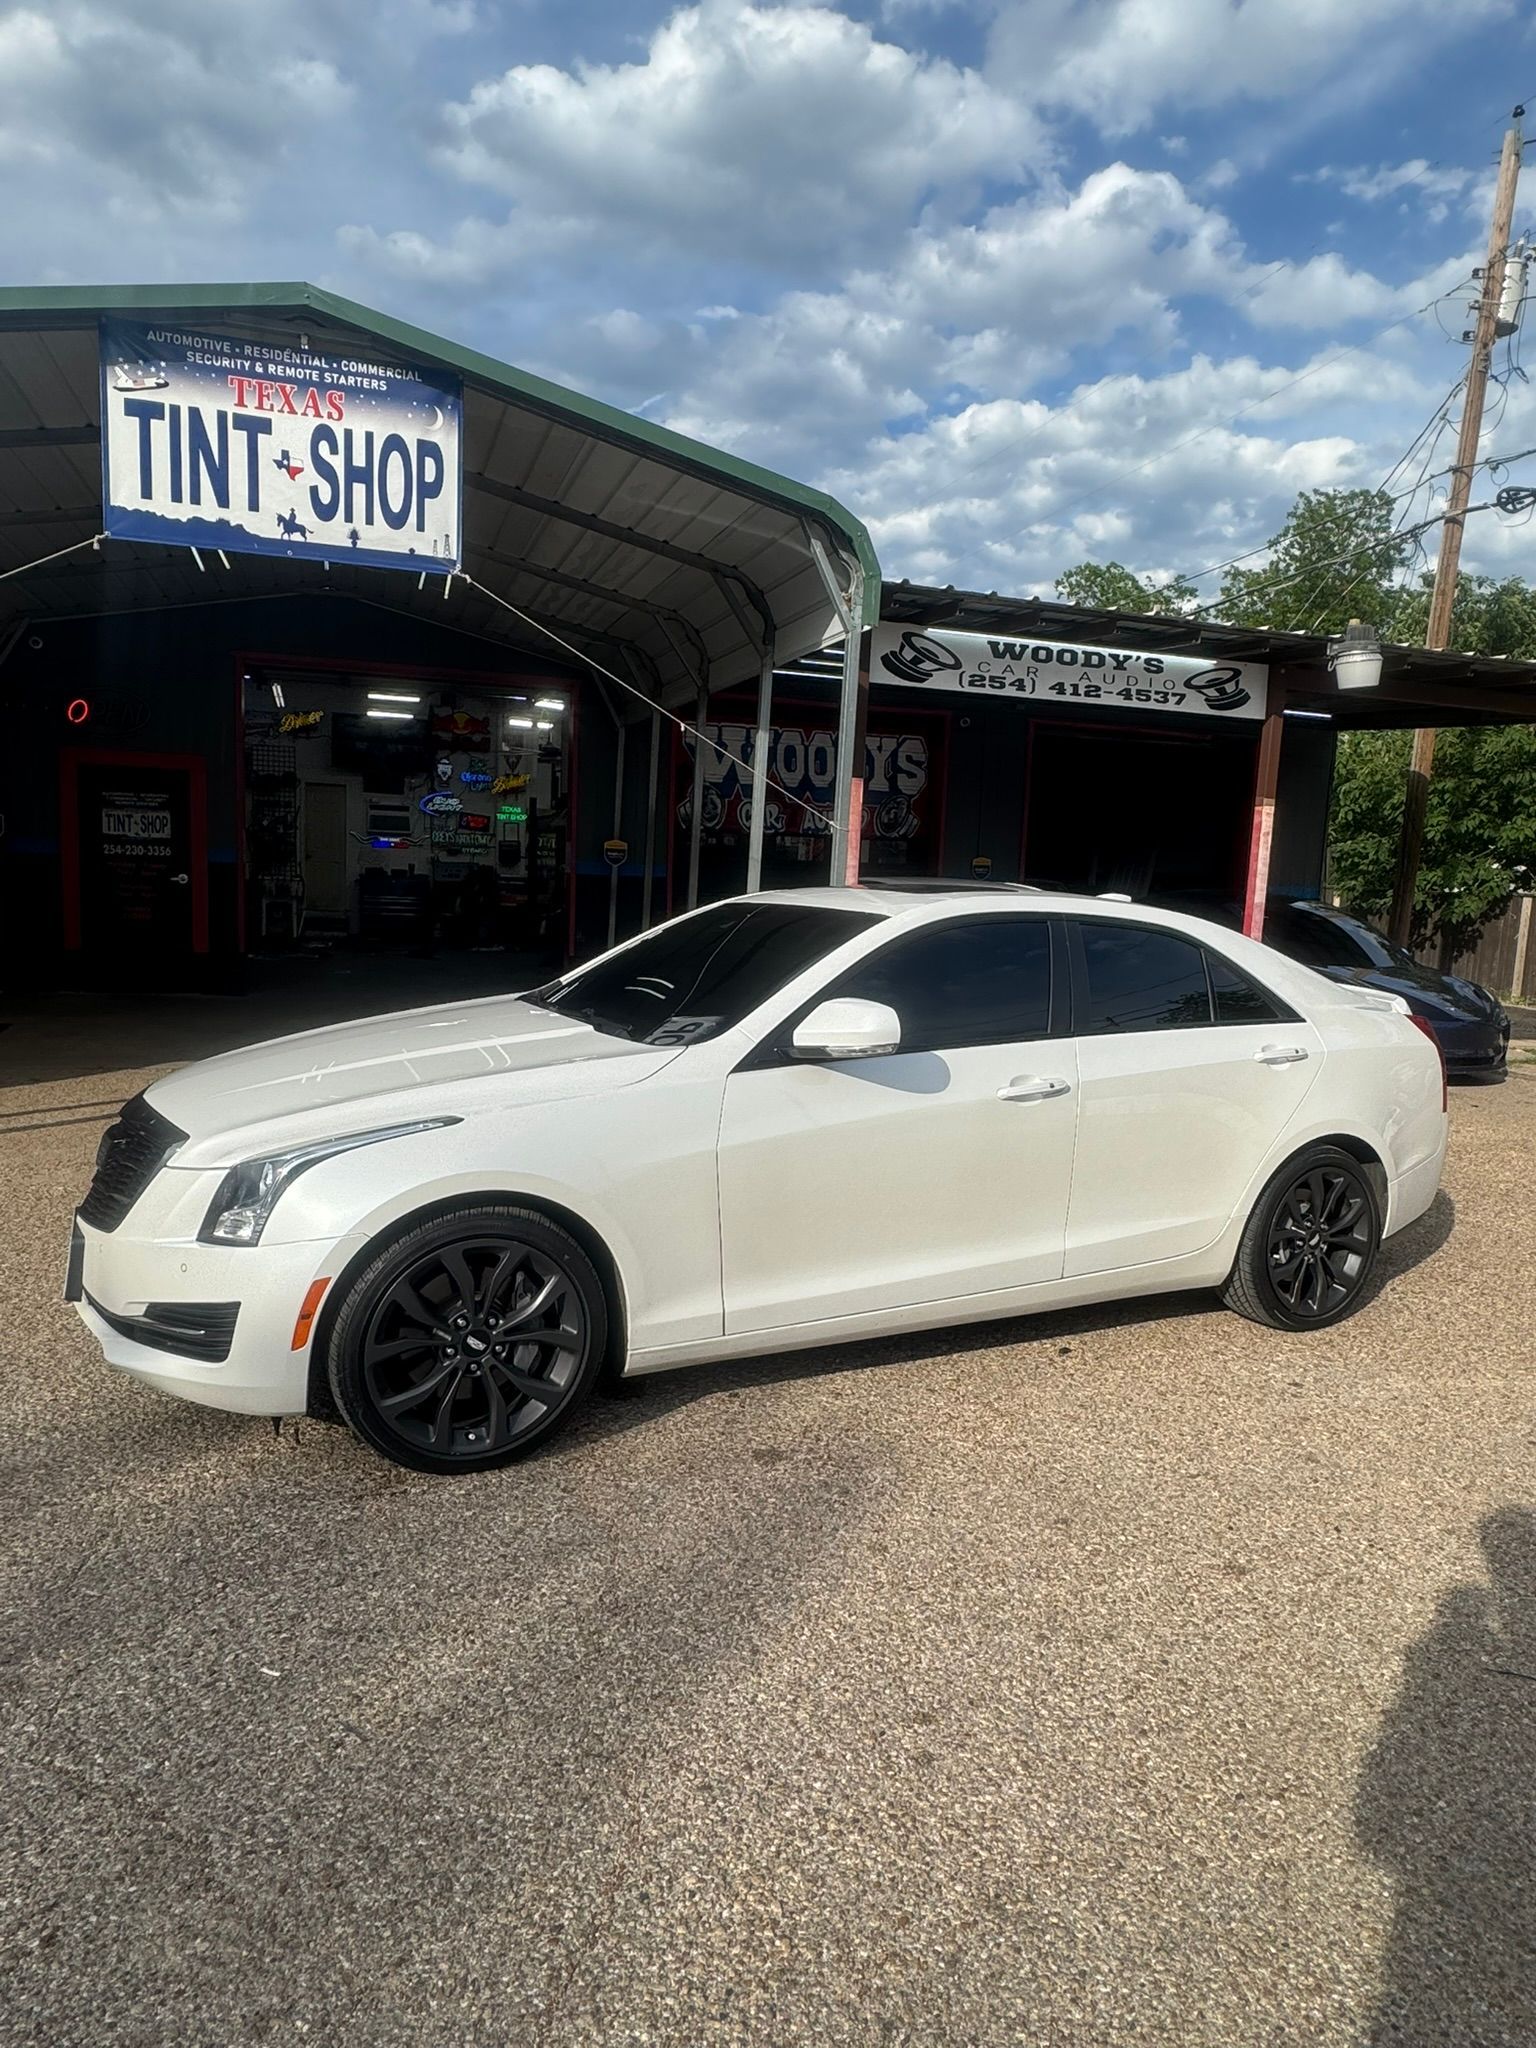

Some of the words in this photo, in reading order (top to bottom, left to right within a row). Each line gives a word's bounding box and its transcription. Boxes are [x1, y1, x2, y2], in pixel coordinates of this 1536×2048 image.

[147, 330, 231, 353] AUTOMOTIVE
[244, 345, 329, 369] RESIDENTIAL
[341, 360, 422, 382] COMMERCIAL
[186, 351, 251, 373] SECURITY
[255, 362, 263, 374] &
[268, 364, 320, 382] REMOTE
[324, 371, 387, 391] STARTERS
[228, 375, 345, 421] TEXAS
[123, 397, 272, 513] TINT
[309, 423, 445, 533] SHOP
[986, 640, 1165, 675] WOODY'S
[958, 671, 1037, 695] (254)
[1048, 680, 1187, 706] 412-4537
[977, 661, 1040, 678] CAR
[1079, 671, 1176, 690] AUDIO
[685, 724, 928, 796] WOOYS
[104, 813, 133, 833] TINT
[140, 814, 169, 834] SHOP
[496, 813, 510, 821] TINT
[511, 813, 527, 821] SHOP
[739, 801, 785, 831] CR
[103, 844, 172, 857] 254-230-3356
